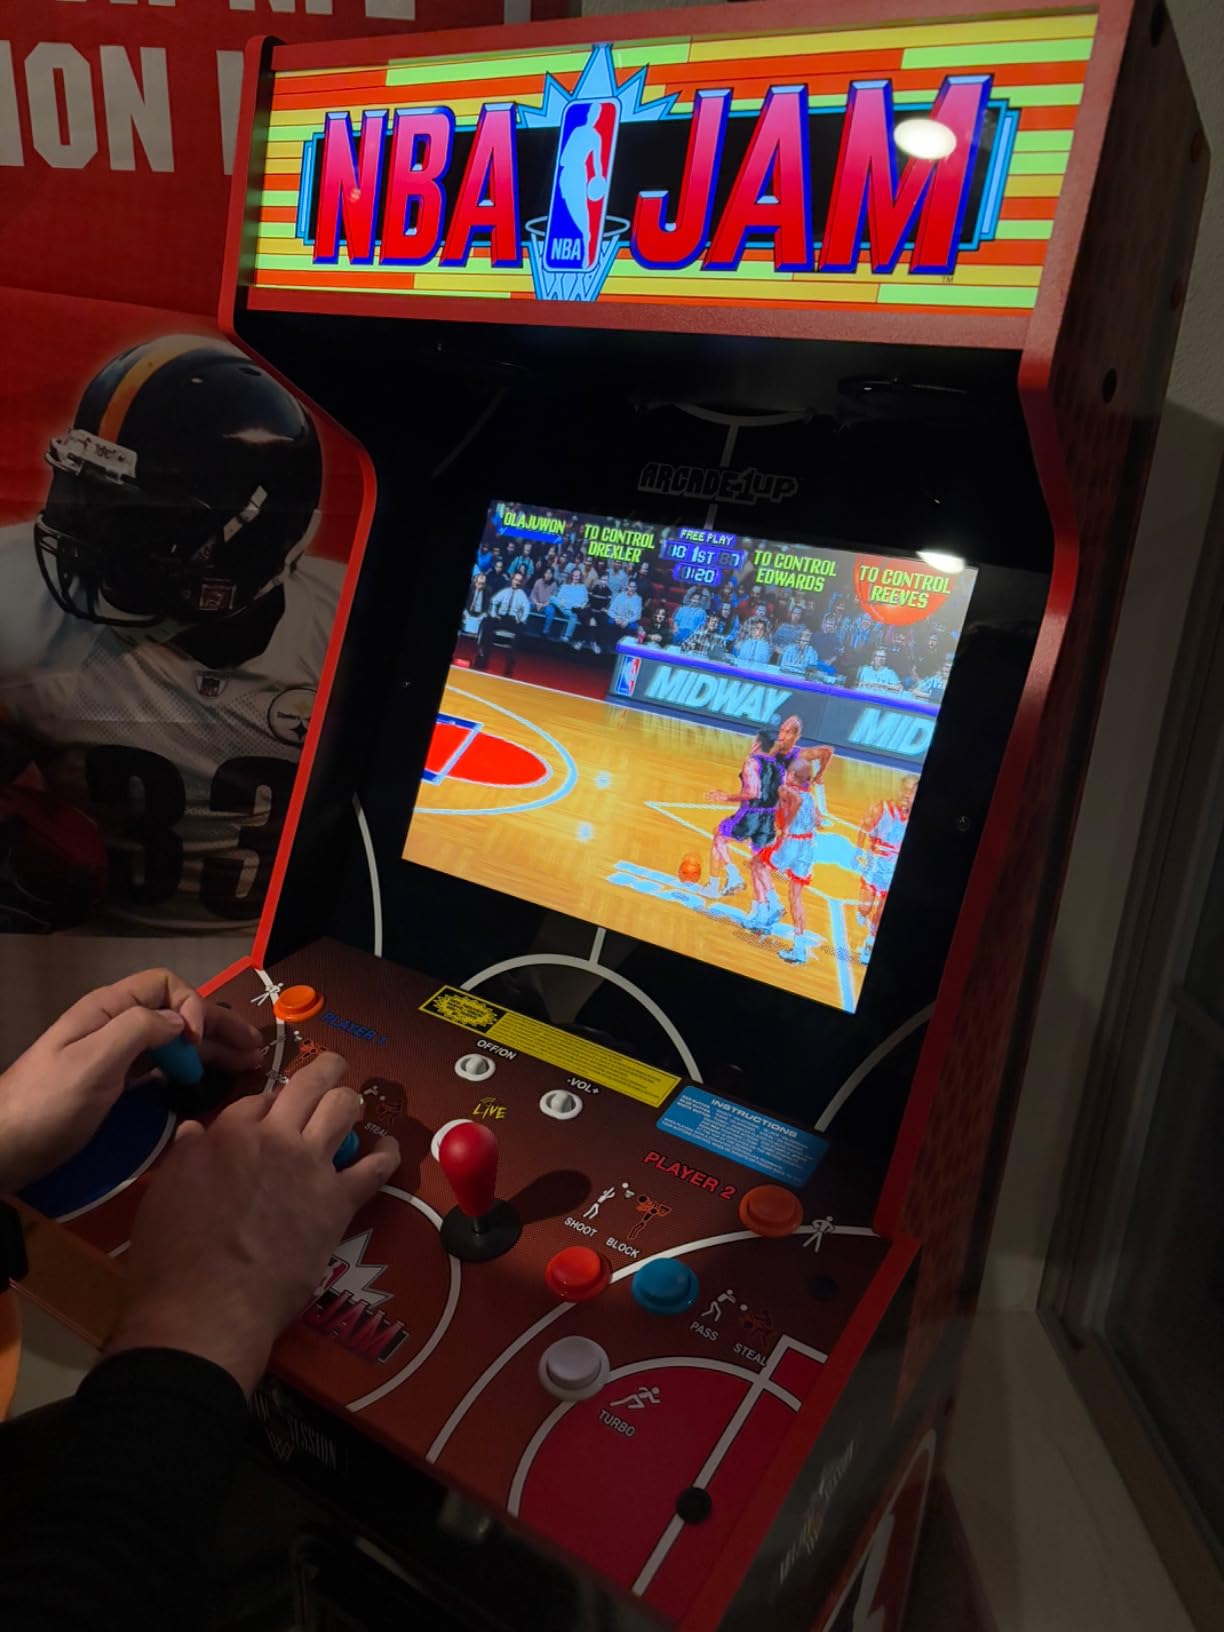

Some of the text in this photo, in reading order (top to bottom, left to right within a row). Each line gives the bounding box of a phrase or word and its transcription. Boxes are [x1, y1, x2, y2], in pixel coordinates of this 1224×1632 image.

[312, 103, 523, 268] NBA
[631, 74, 995, 275] JAM
[551, 238, 581, 261] NBA
[503, 511, 567, 535] OLAJUWON
[584, 523, 655, 549] TO CONTROL
[680, 529, 735, 546] FREE PLAY
[588, 541, 643, 563] DREXLER
[691, 546, 716, 565] 1ST
[754, 550, 837, 577] TO CONTROL
[755, 568, 826, 593] EDWARDS
[859, 565, 951, 594] TO CONTROL
[870, 585, 930, 609] REEVES
[645, 665, 937, 756] MIDWAY MID
[476, 1038, 518, 1061] OFF/ON
[711, 1099, 798, 1138] INSTRUCTIONS
[642, 1150, 737, 1200] PLAYER 2
[564, 1216, 599, 1238] SHOOT
[605, 1236, 641, 1259] BLOCK
[689, 1321, 720, 1342] PASS
[732, 1342, 767, 1368] STEAL
[599, 1409, 636, 1438] TURBO
